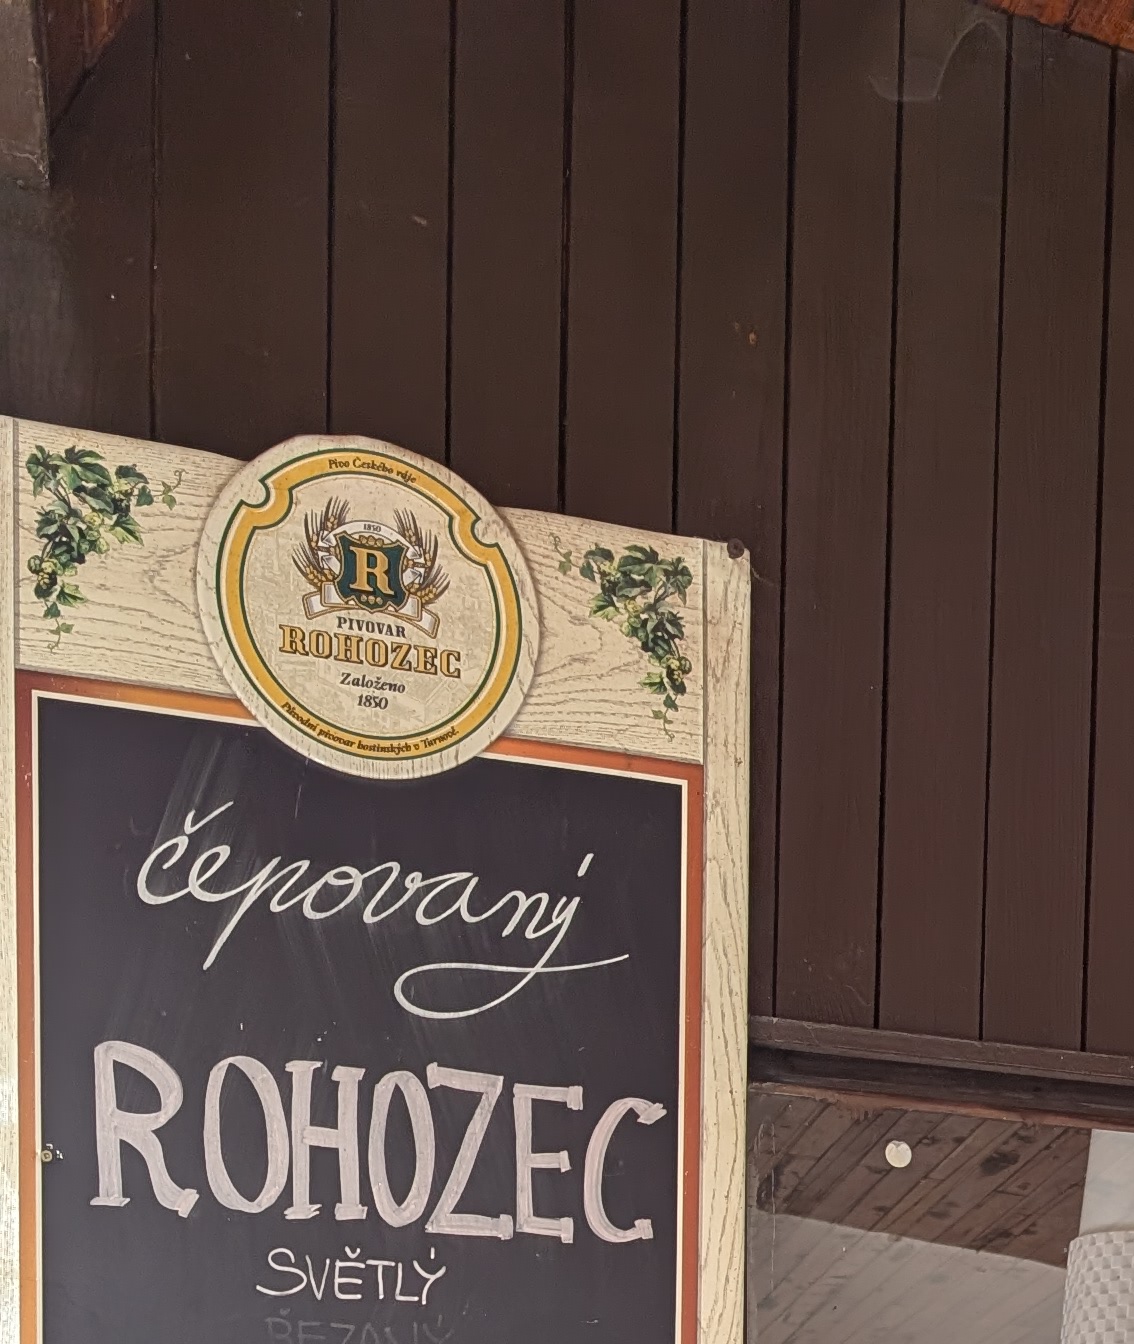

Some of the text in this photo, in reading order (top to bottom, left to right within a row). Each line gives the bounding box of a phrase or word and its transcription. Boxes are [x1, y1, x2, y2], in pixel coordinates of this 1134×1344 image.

[350, 549, 395, 597] R
[278, 624, 462, 679] ROHOZEC
[336, 615, 407, 639] PIVOVAR
[340, 671, 406, 695] Založeno
[357, 694, 389, 711] 1850
[136, 801, 630, 1019] čepovaný
[89, 1039, 668, 1244] ROHOZEC
[254, 1246, 448, 1305] SVĚTLÝ
